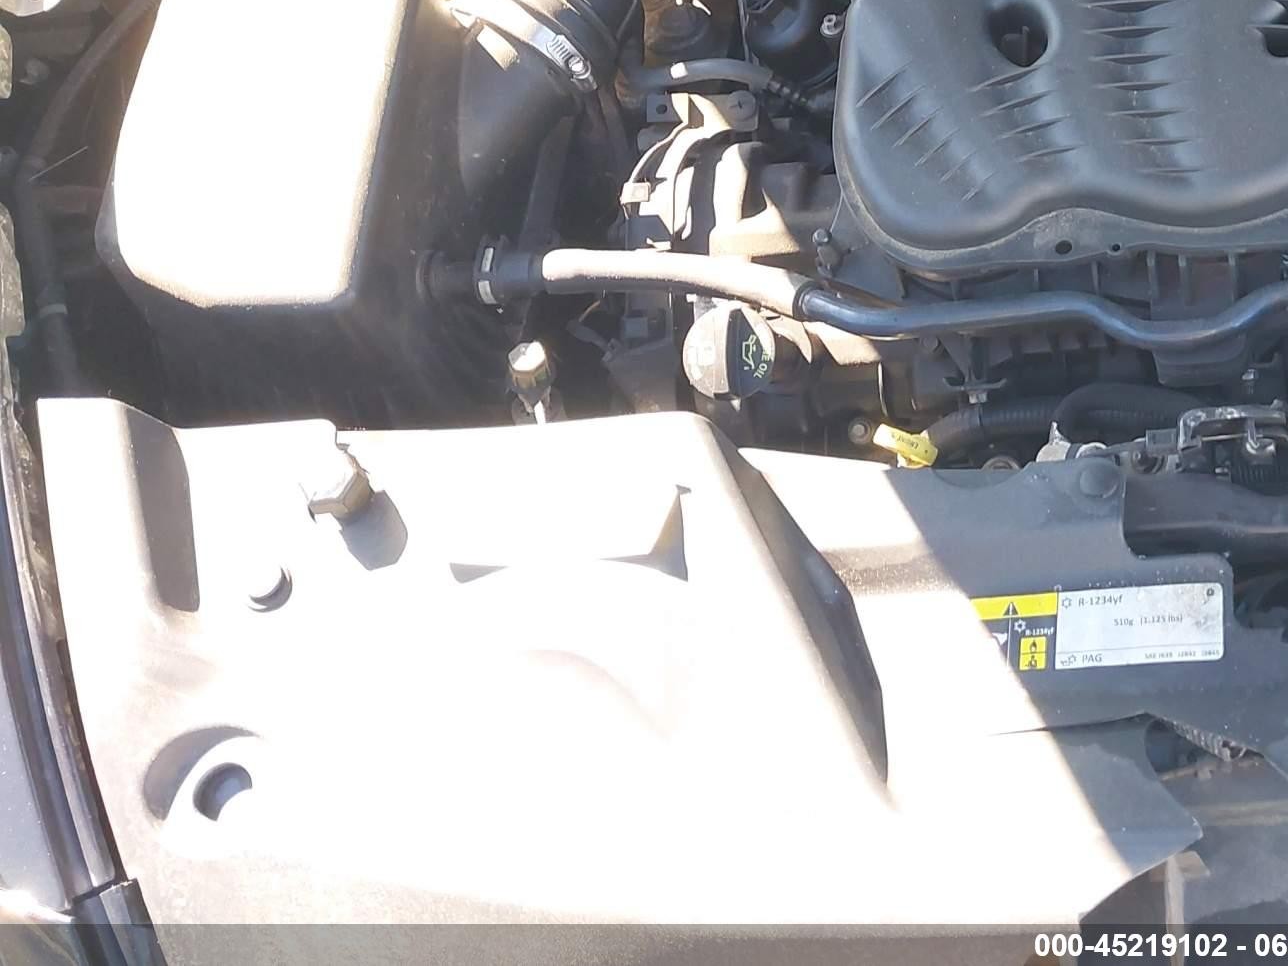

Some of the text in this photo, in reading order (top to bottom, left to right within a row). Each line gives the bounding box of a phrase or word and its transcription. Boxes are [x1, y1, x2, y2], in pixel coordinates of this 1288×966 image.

[753, 362, 769, 379] OIL
[1078, 594, 1123, 607] R-1234yf
[1113, 617, 1135, 627] 510g
[1082, 652, 1103, 663] PAG
